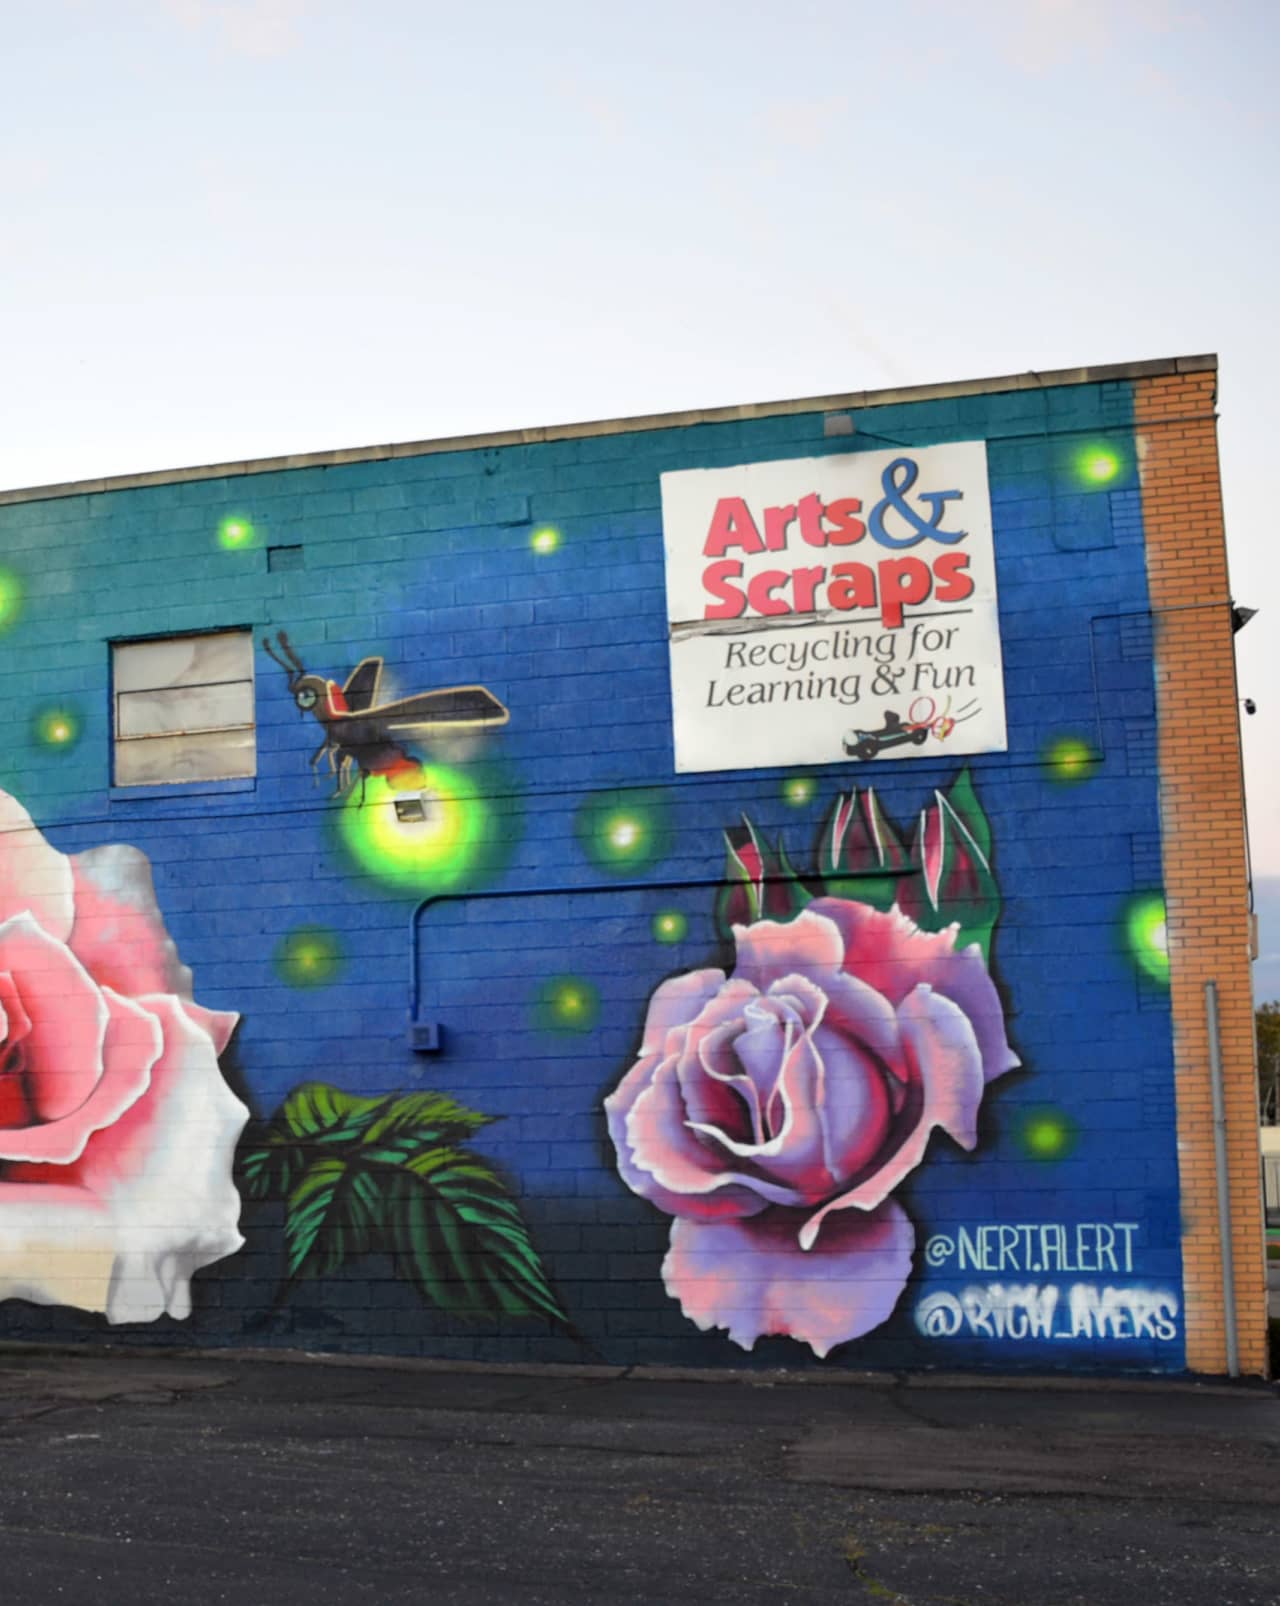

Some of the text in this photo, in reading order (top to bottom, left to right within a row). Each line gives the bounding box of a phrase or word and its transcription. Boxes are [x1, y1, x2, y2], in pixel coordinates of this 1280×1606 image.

[702, 552, 975, 629] Scraps
[725, 624, 959, 671] Recycling for
[706, 663, 975, 707] Learning & Fun
